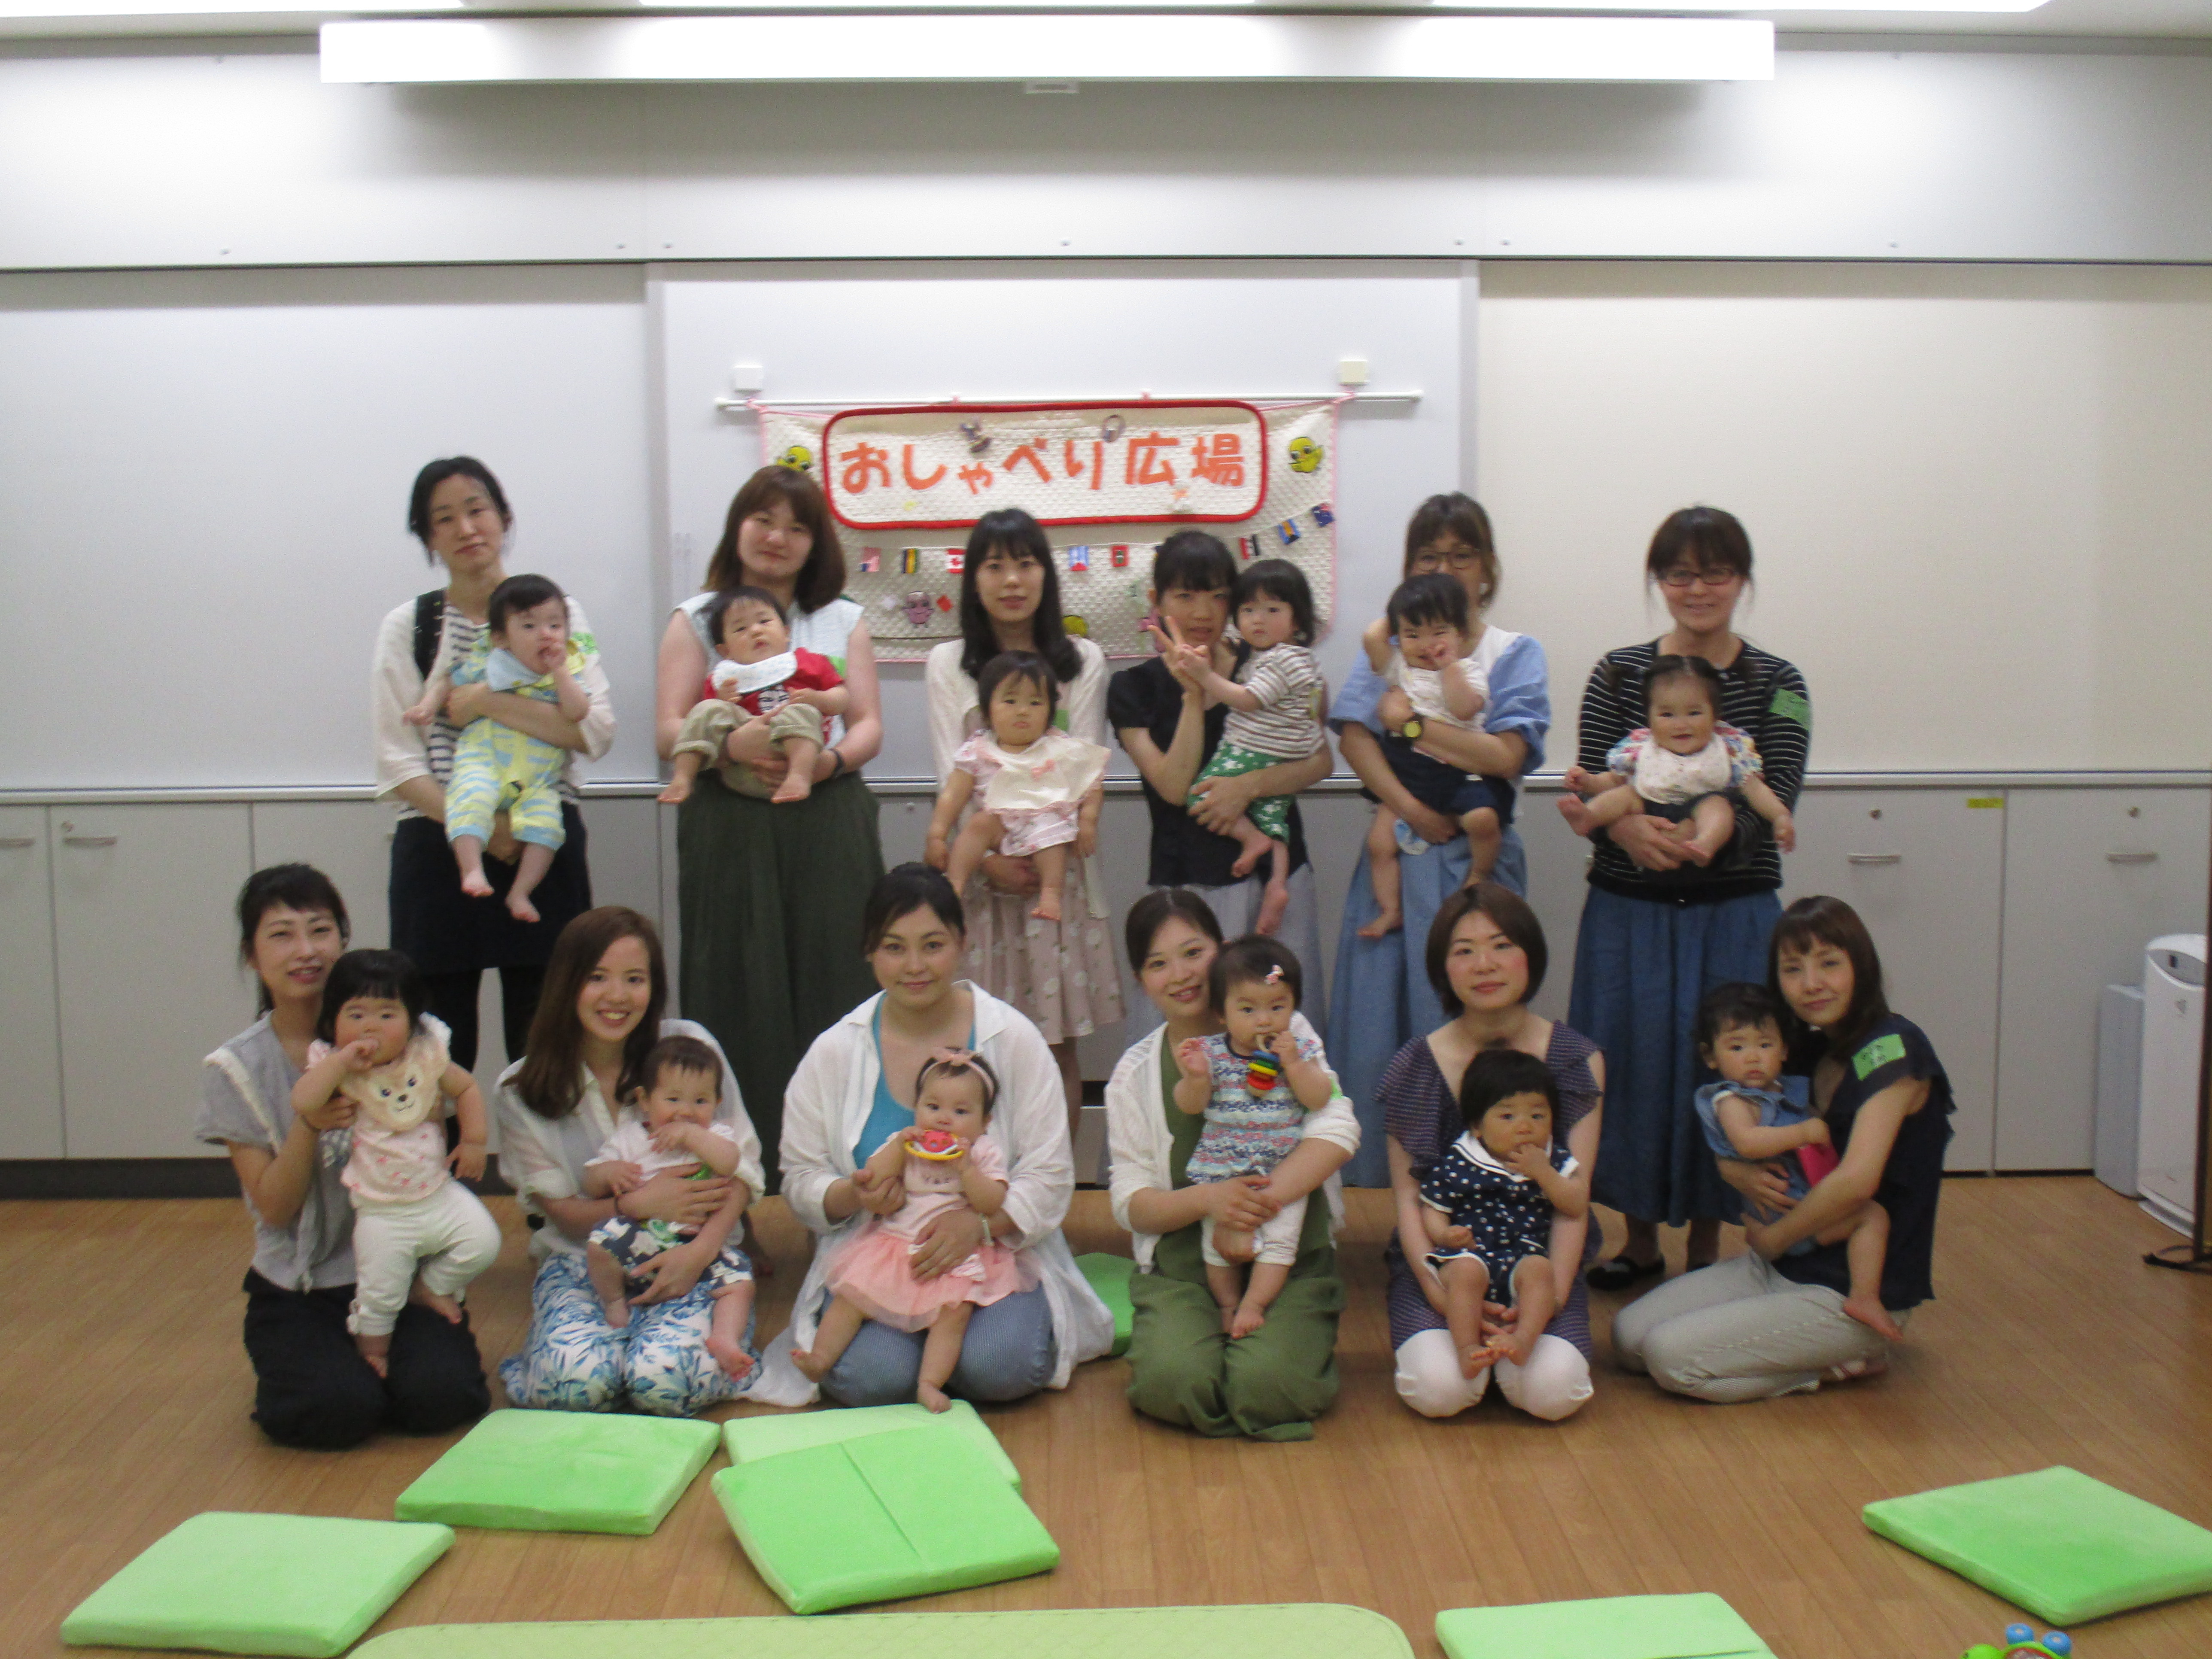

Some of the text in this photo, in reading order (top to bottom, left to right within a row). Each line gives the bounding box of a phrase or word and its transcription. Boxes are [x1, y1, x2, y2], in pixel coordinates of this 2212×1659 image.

[840, 431, 1245, 494] おしゃべり広場
